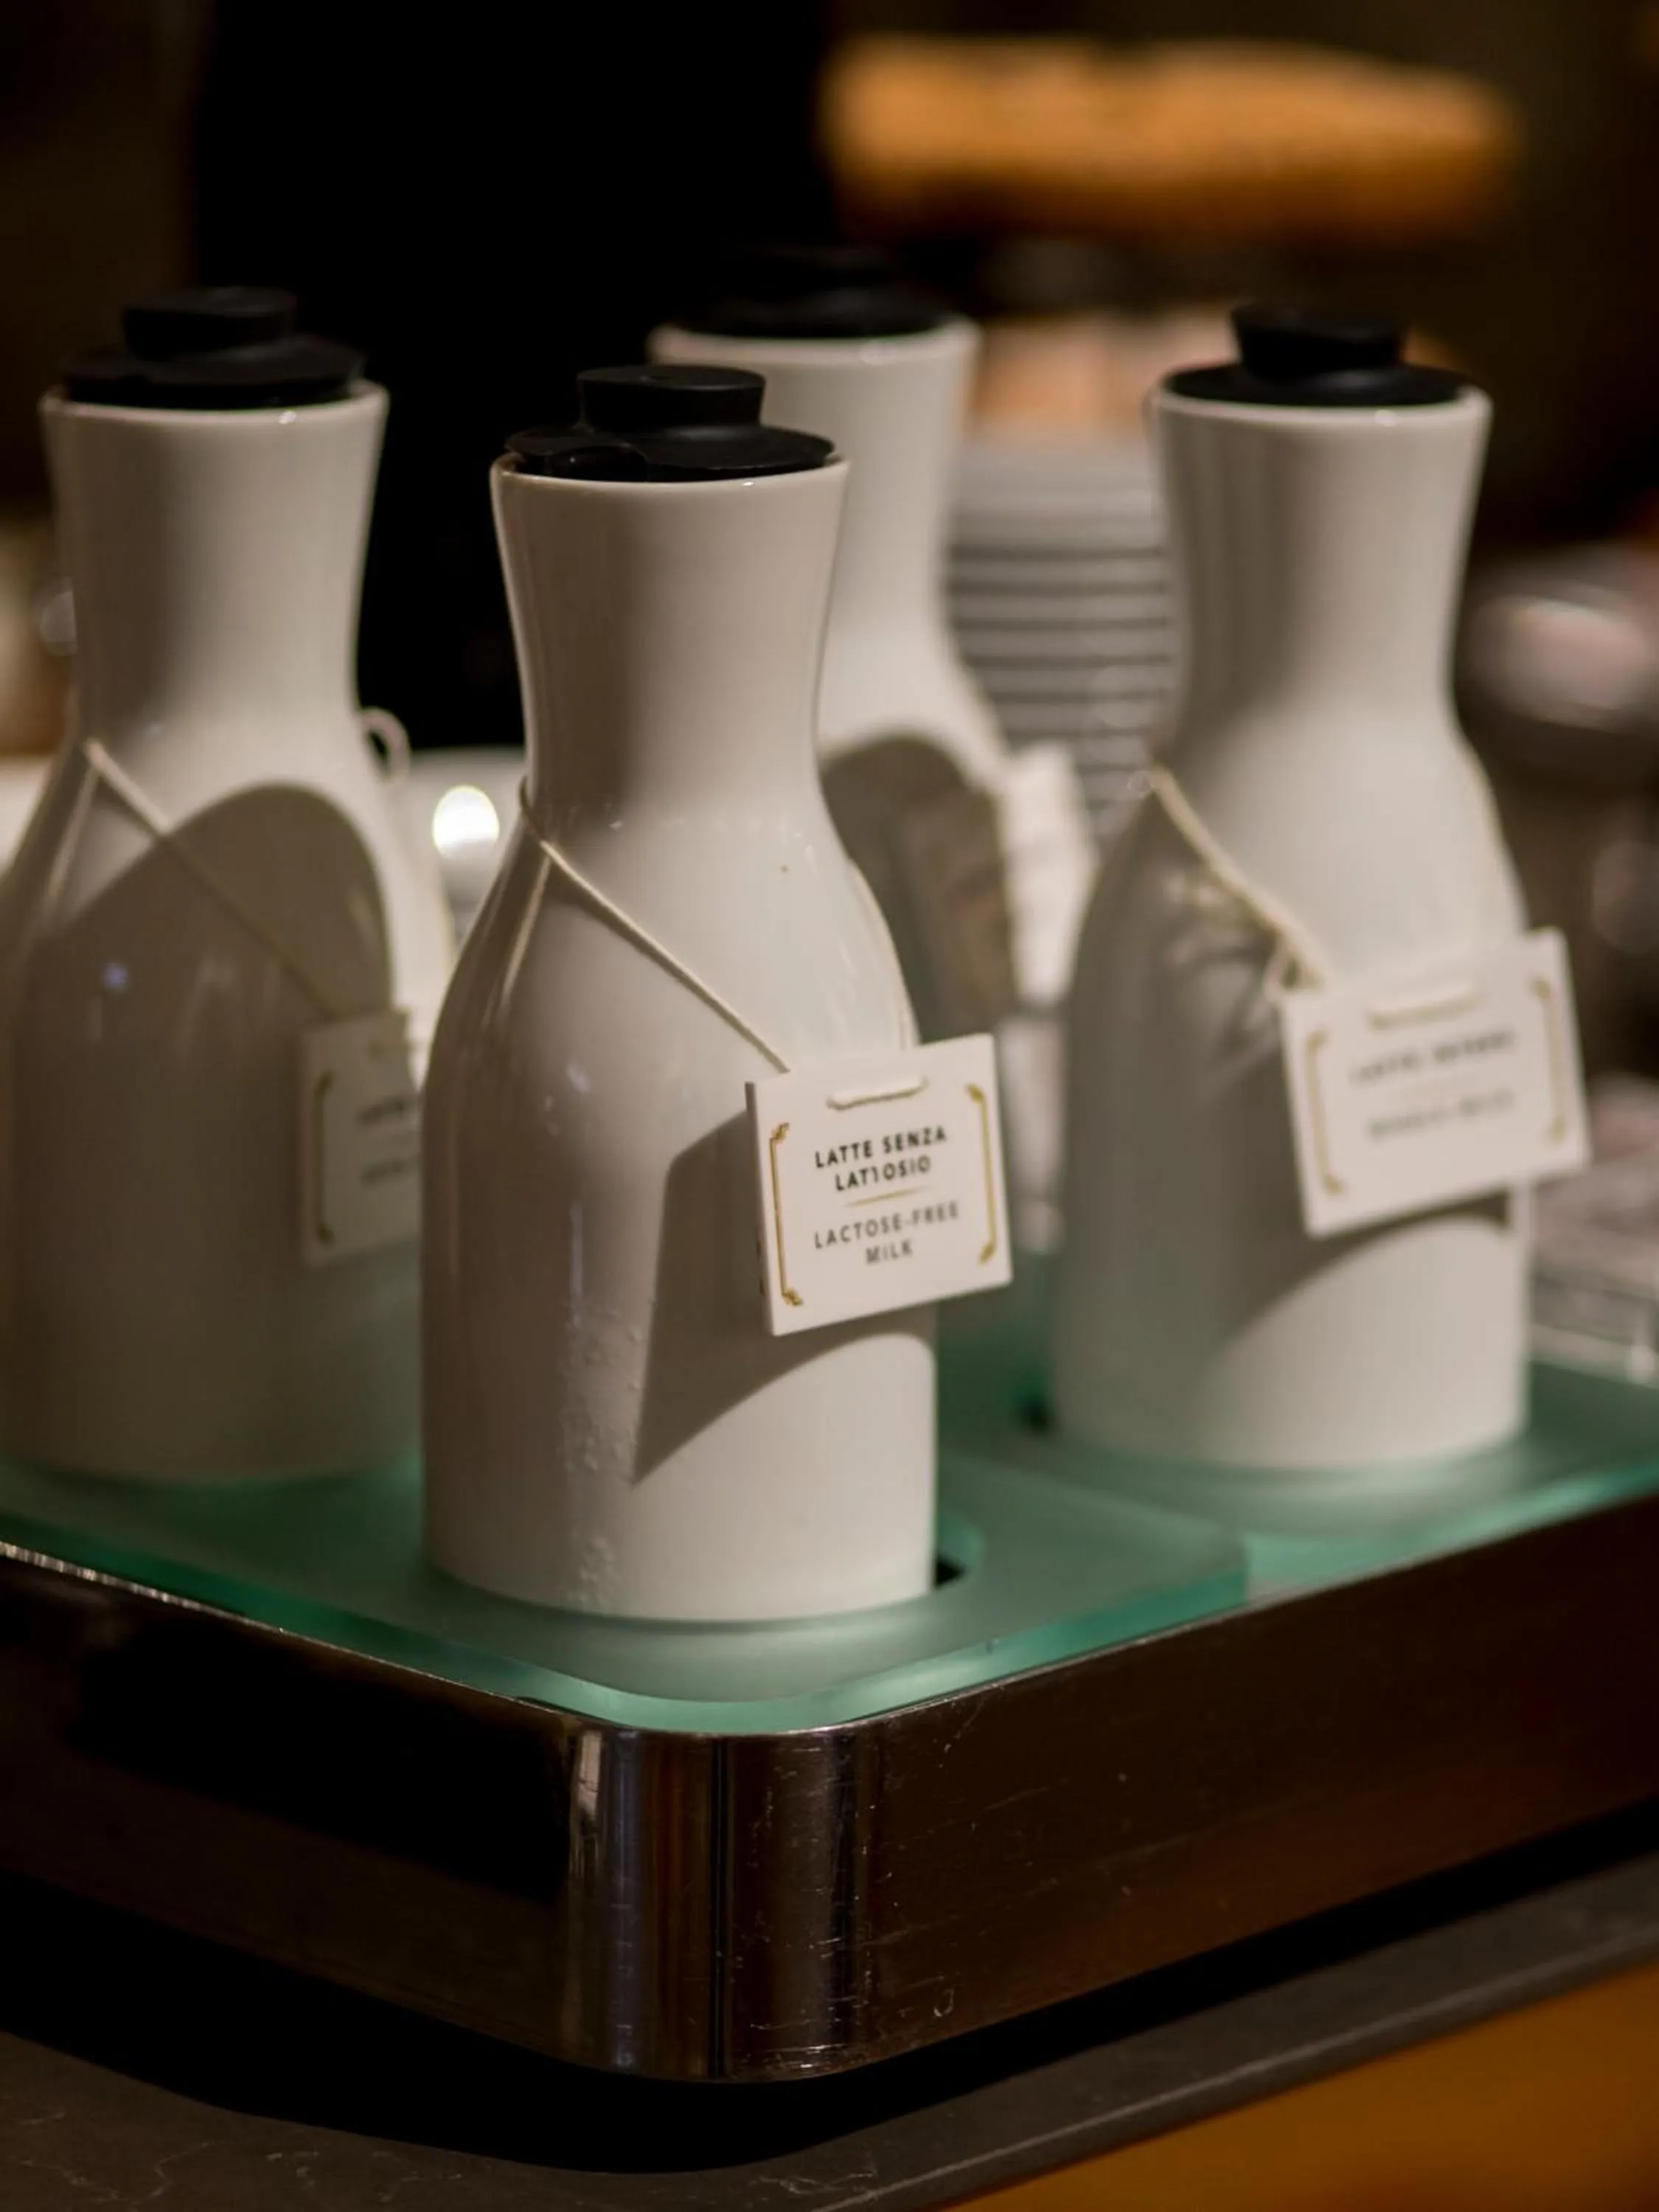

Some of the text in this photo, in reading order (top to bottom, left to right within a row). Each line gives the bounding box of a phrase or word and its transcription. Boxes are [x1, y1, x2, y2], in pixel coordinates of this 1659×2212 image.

[815, 1126, 947, 1168] LATTE SENZA
[866, 1239, 913, 1265] MILK
